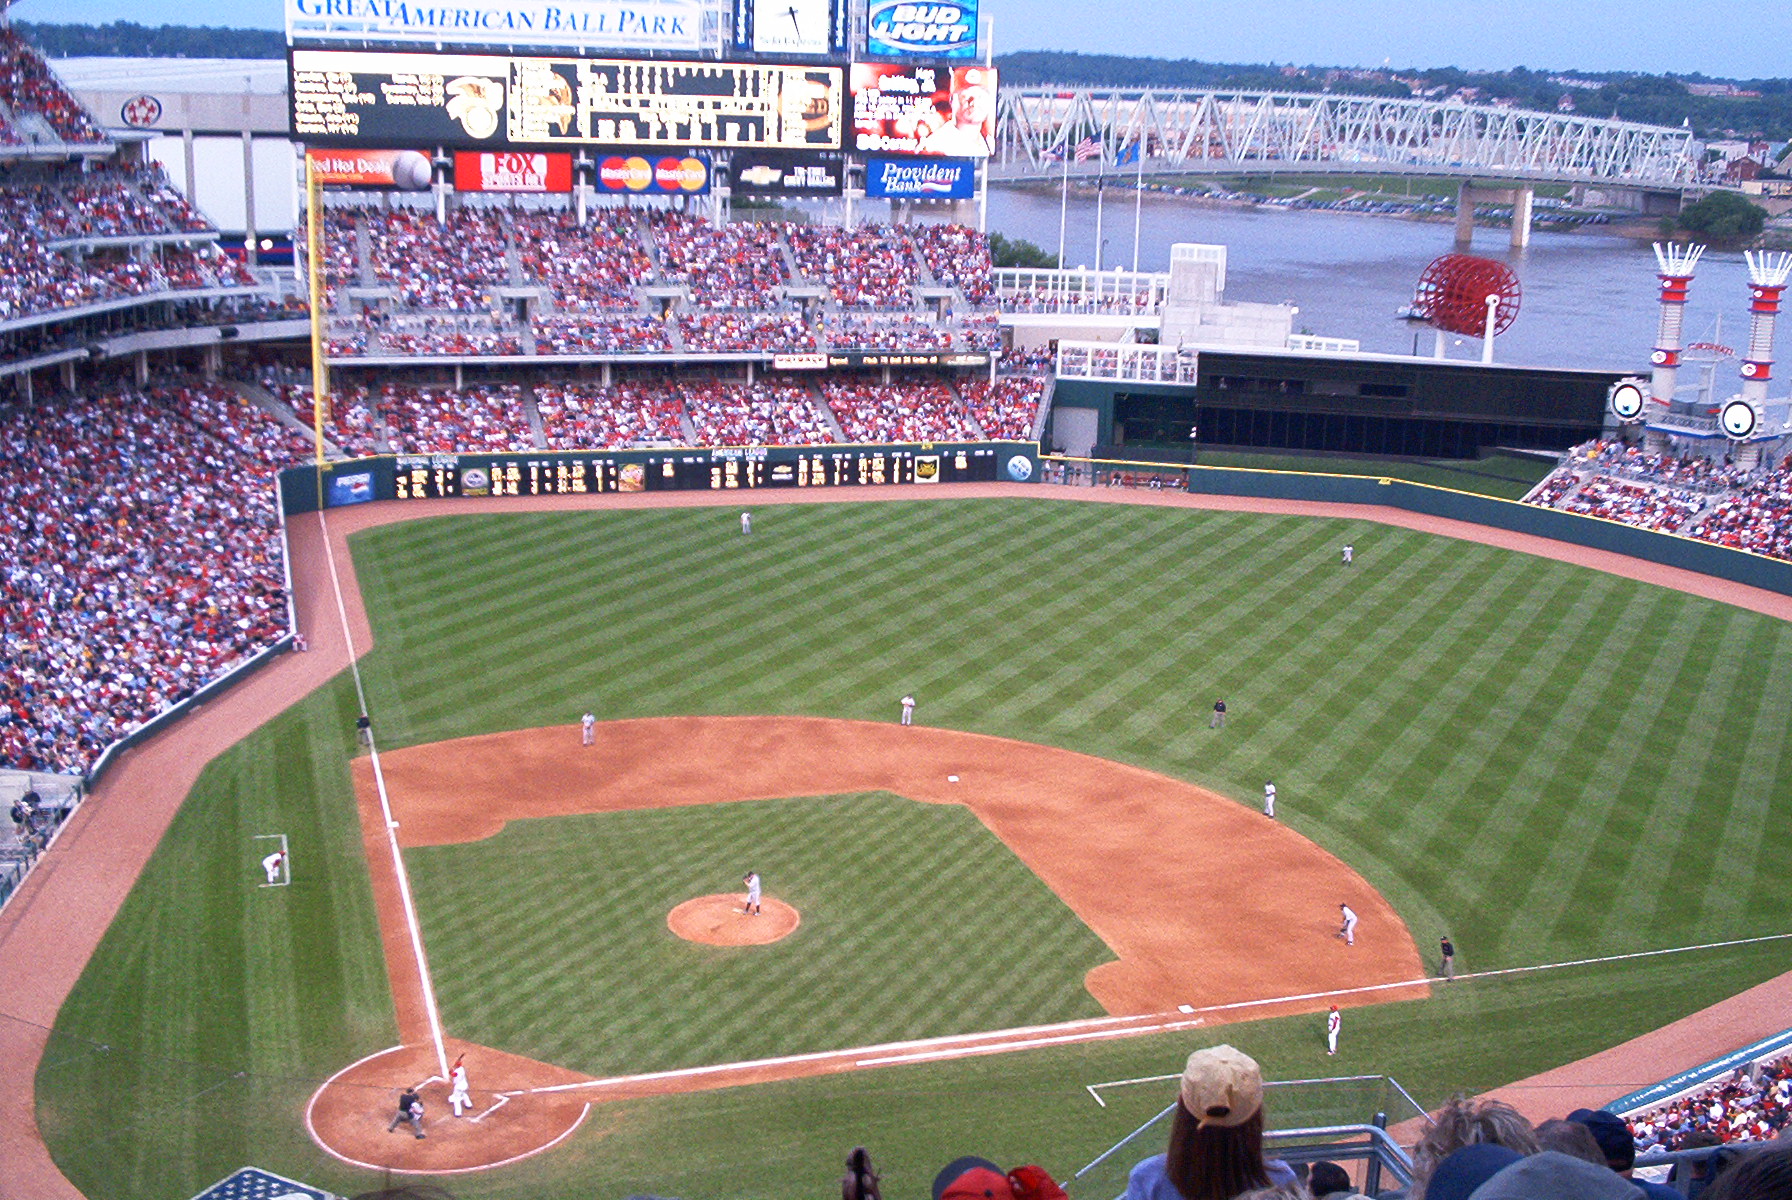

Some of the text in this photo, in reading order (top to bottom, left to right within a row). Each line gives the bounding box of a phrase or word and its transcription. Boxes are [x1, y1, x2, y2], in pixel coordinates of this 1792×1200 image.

[388, 2, 536, 29] AMERICAN
[544, 8, 613, 33] BALL
[618, 11, 686, 35] PARK
[892, 5, 962, 24] BUD
[872, 21, 970, 41] LIGHT
[495, 152, 537, 174] FOX
[881, 163, 961, 183] Provident
[884, 176, 922, 193] Bank
